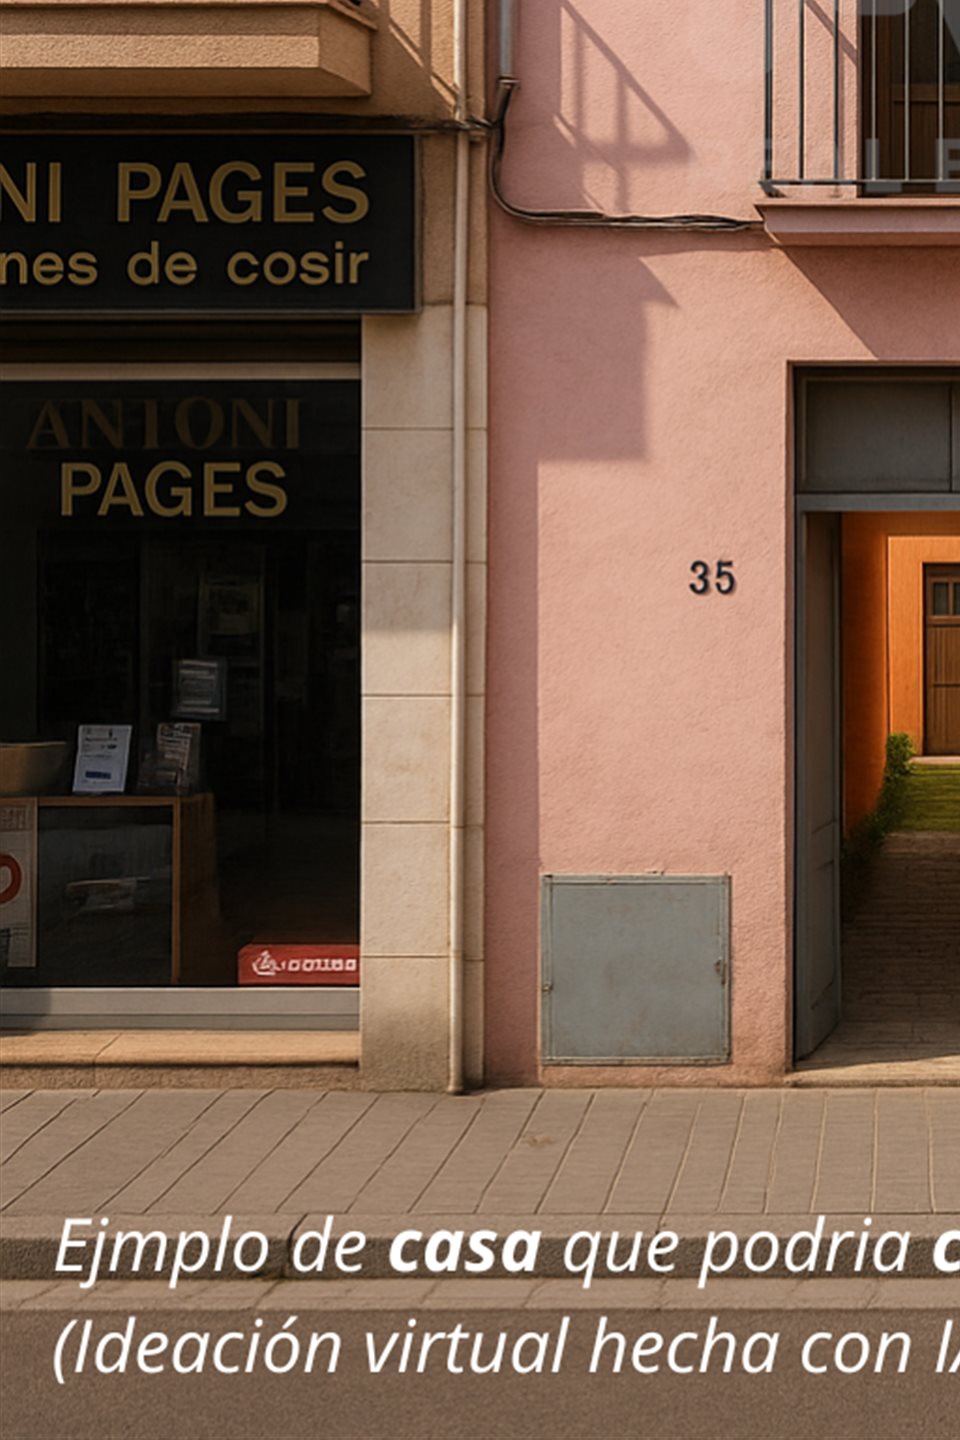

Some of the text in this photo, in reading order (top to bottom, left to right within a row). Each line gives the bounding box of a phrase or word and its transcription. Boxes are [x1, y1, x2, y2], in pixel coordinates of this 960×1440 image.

[117, 161, 370, 223] PAGES
[0, 241, 369, 285] nes de cosir
[60, 461, 288, 517] PAGES
[689, 560, 736, 594] 35
